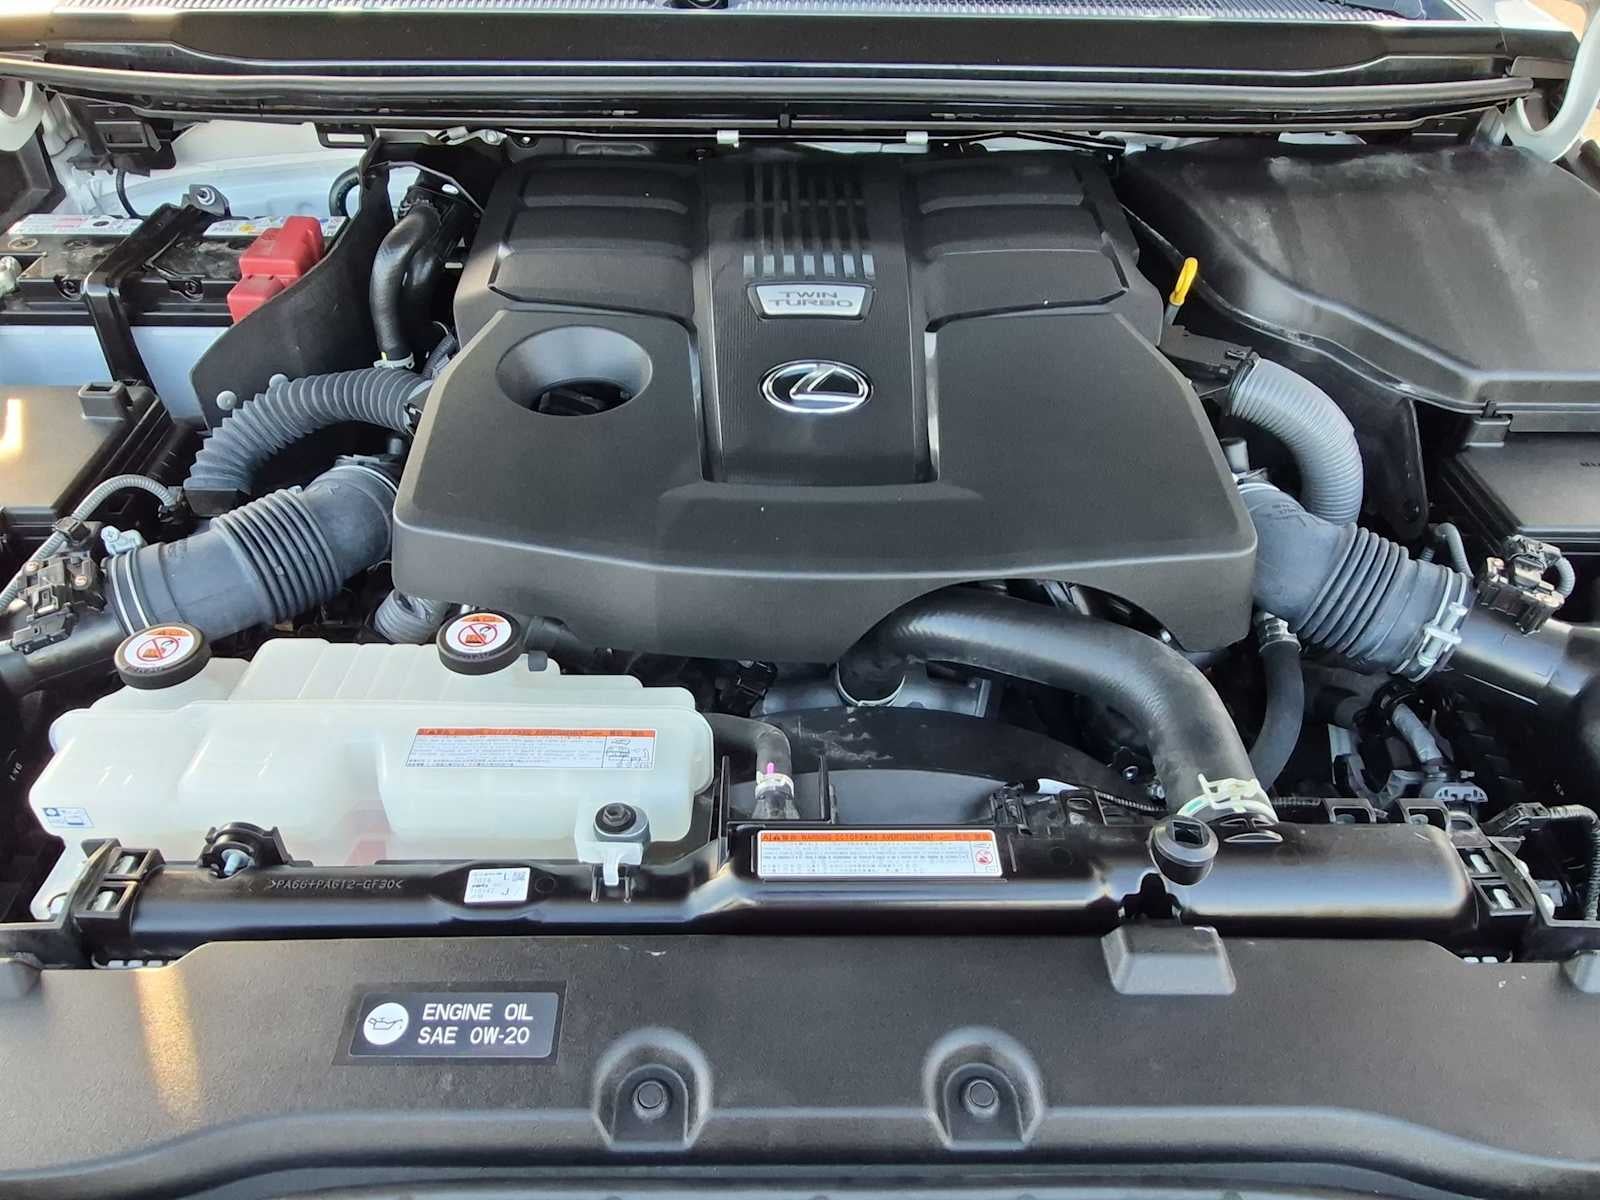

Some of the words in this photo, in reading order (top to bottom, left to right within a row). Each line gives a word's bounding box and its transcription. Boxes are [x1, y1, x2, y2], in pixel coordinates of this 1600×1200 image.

[768, 299, 853, 307] TURBO
[422, 1003, 493, 1020] ENGINE
[504, 1003, 534, 1020] OIL
[417, 1027, 459, 1044] SAE
[470, 1026, 530, 1044] 0W-20
